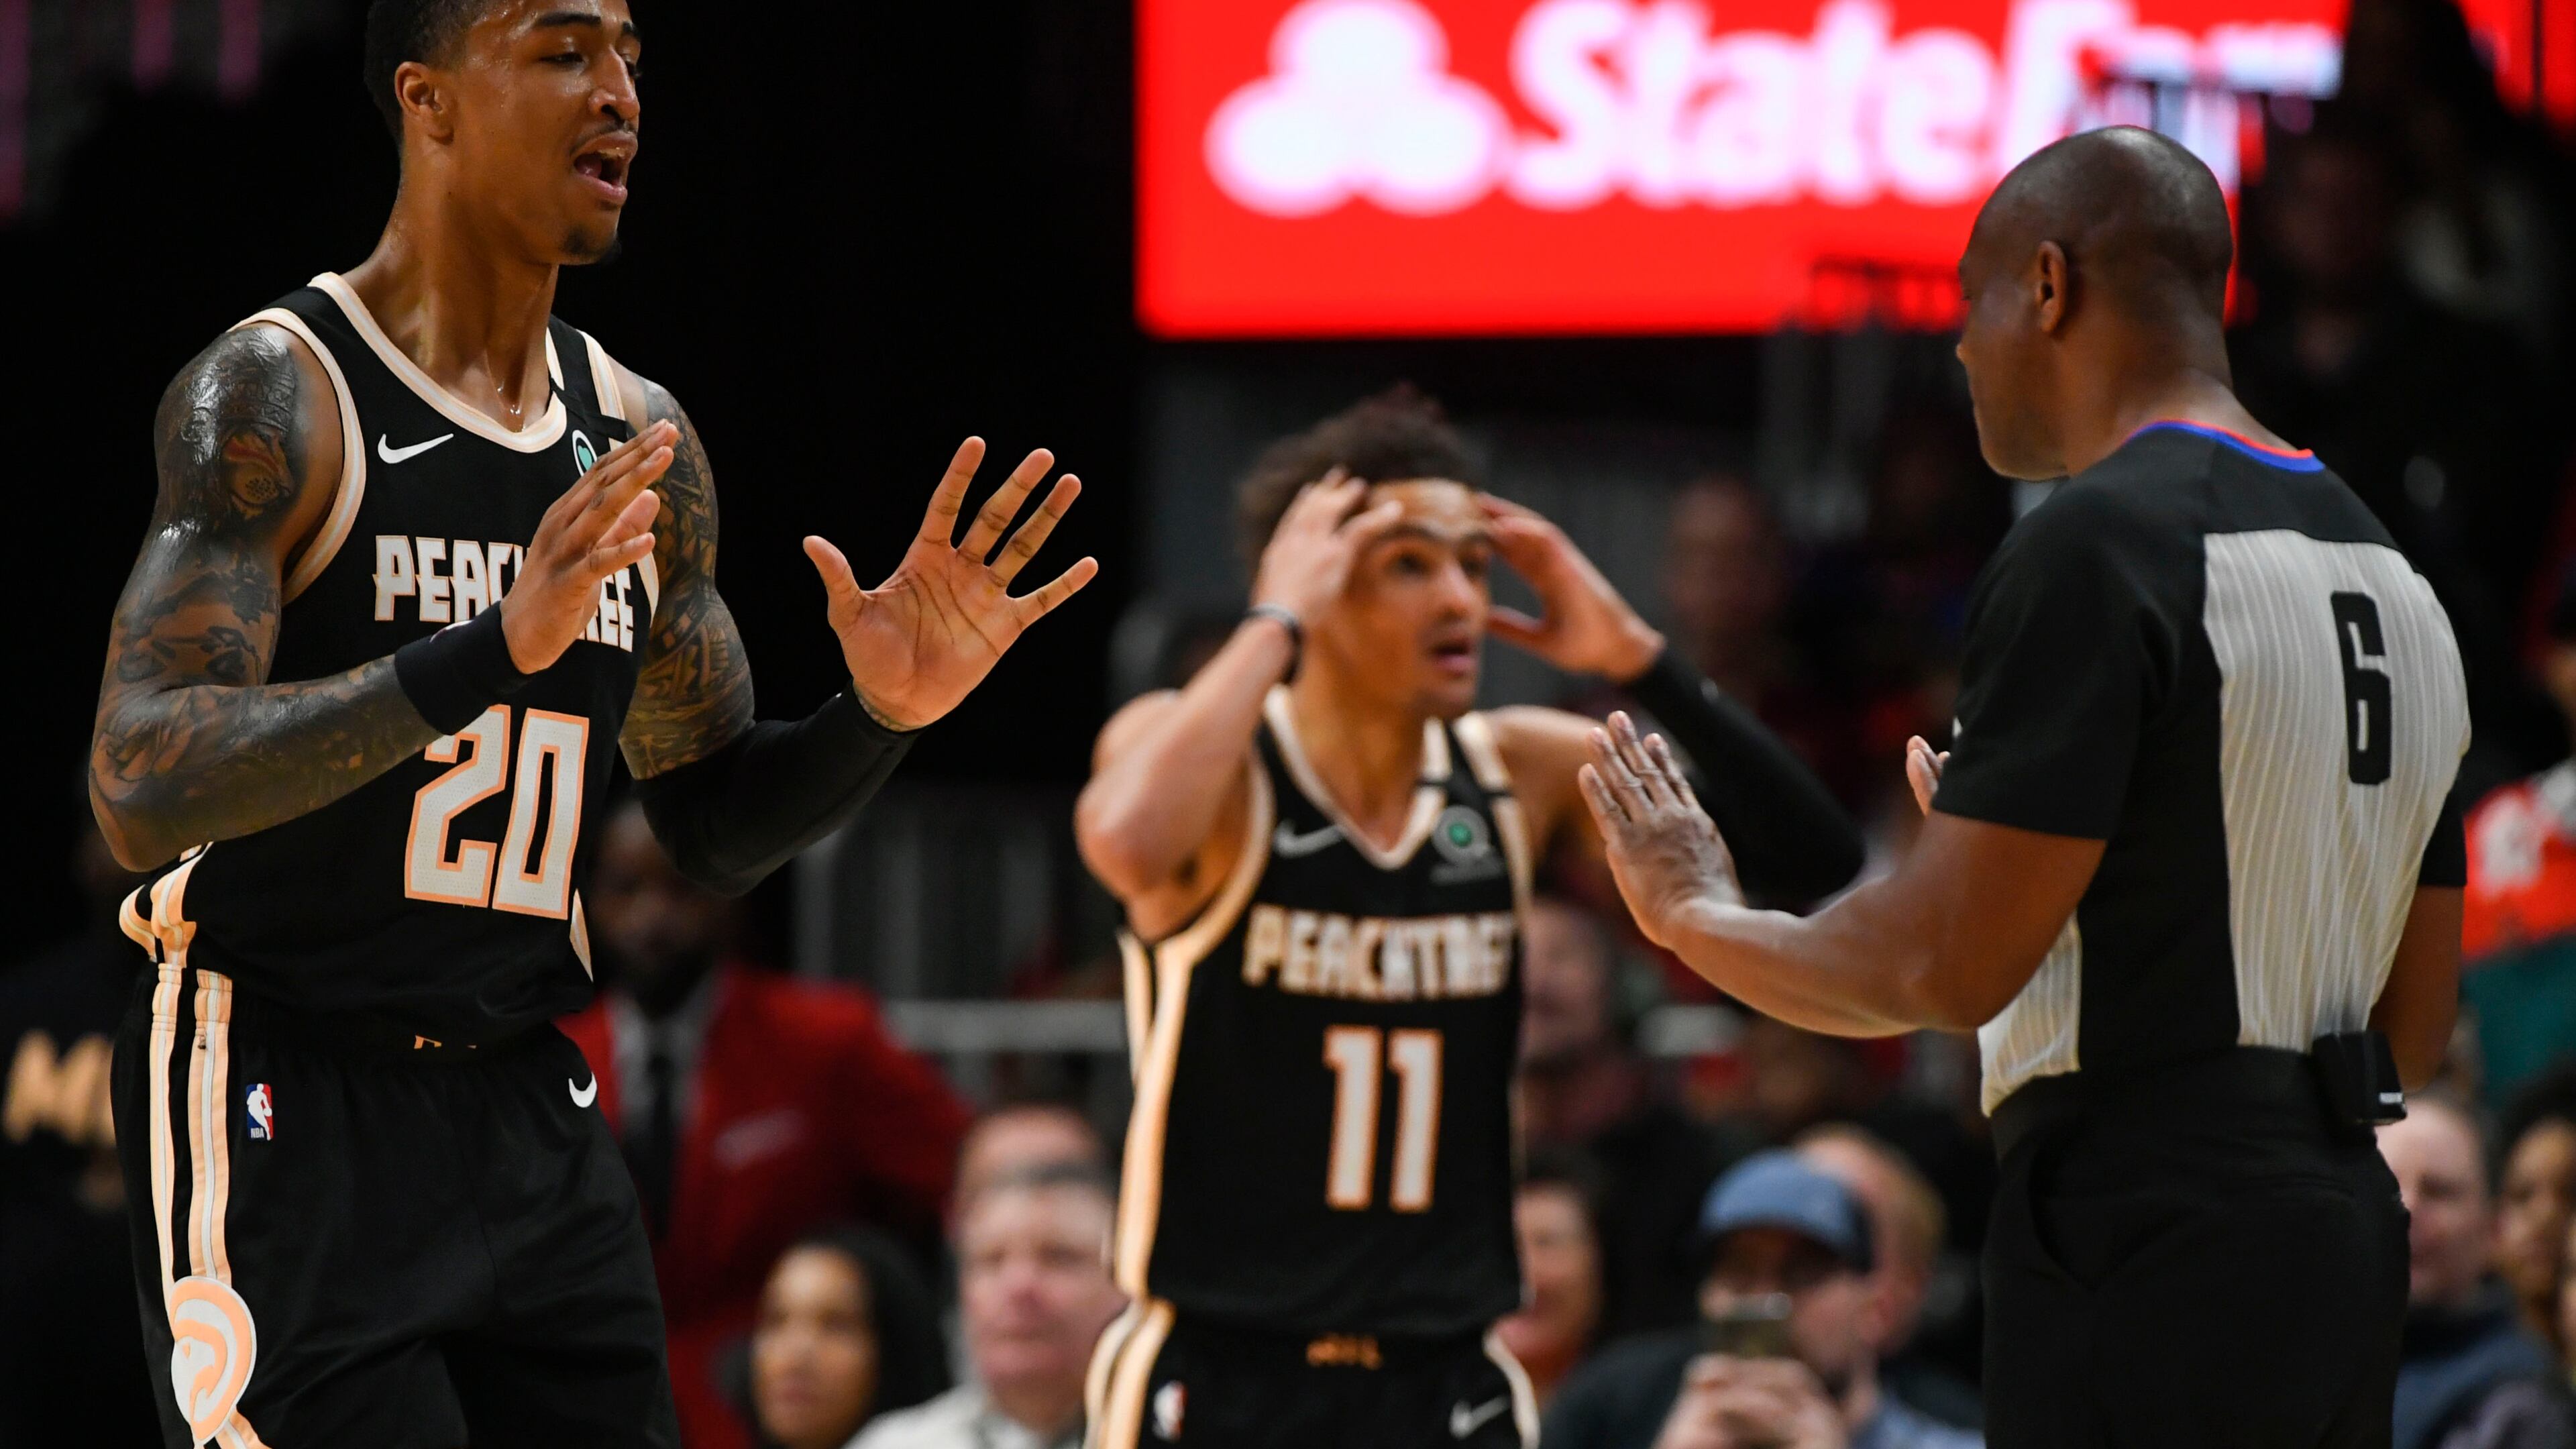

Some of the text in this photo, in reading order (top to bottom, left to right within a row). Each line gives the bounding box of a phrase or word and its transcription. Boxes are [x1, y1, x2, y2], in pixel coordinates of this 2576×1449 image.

[1507, 0, 1998, 209] State
[2330, 590, 2393, 786] 6
[405, 704, 589, 920] 20
[250, 1128, 264, 1138] NBA
[1322, 1024, 1445, 1213] 11
